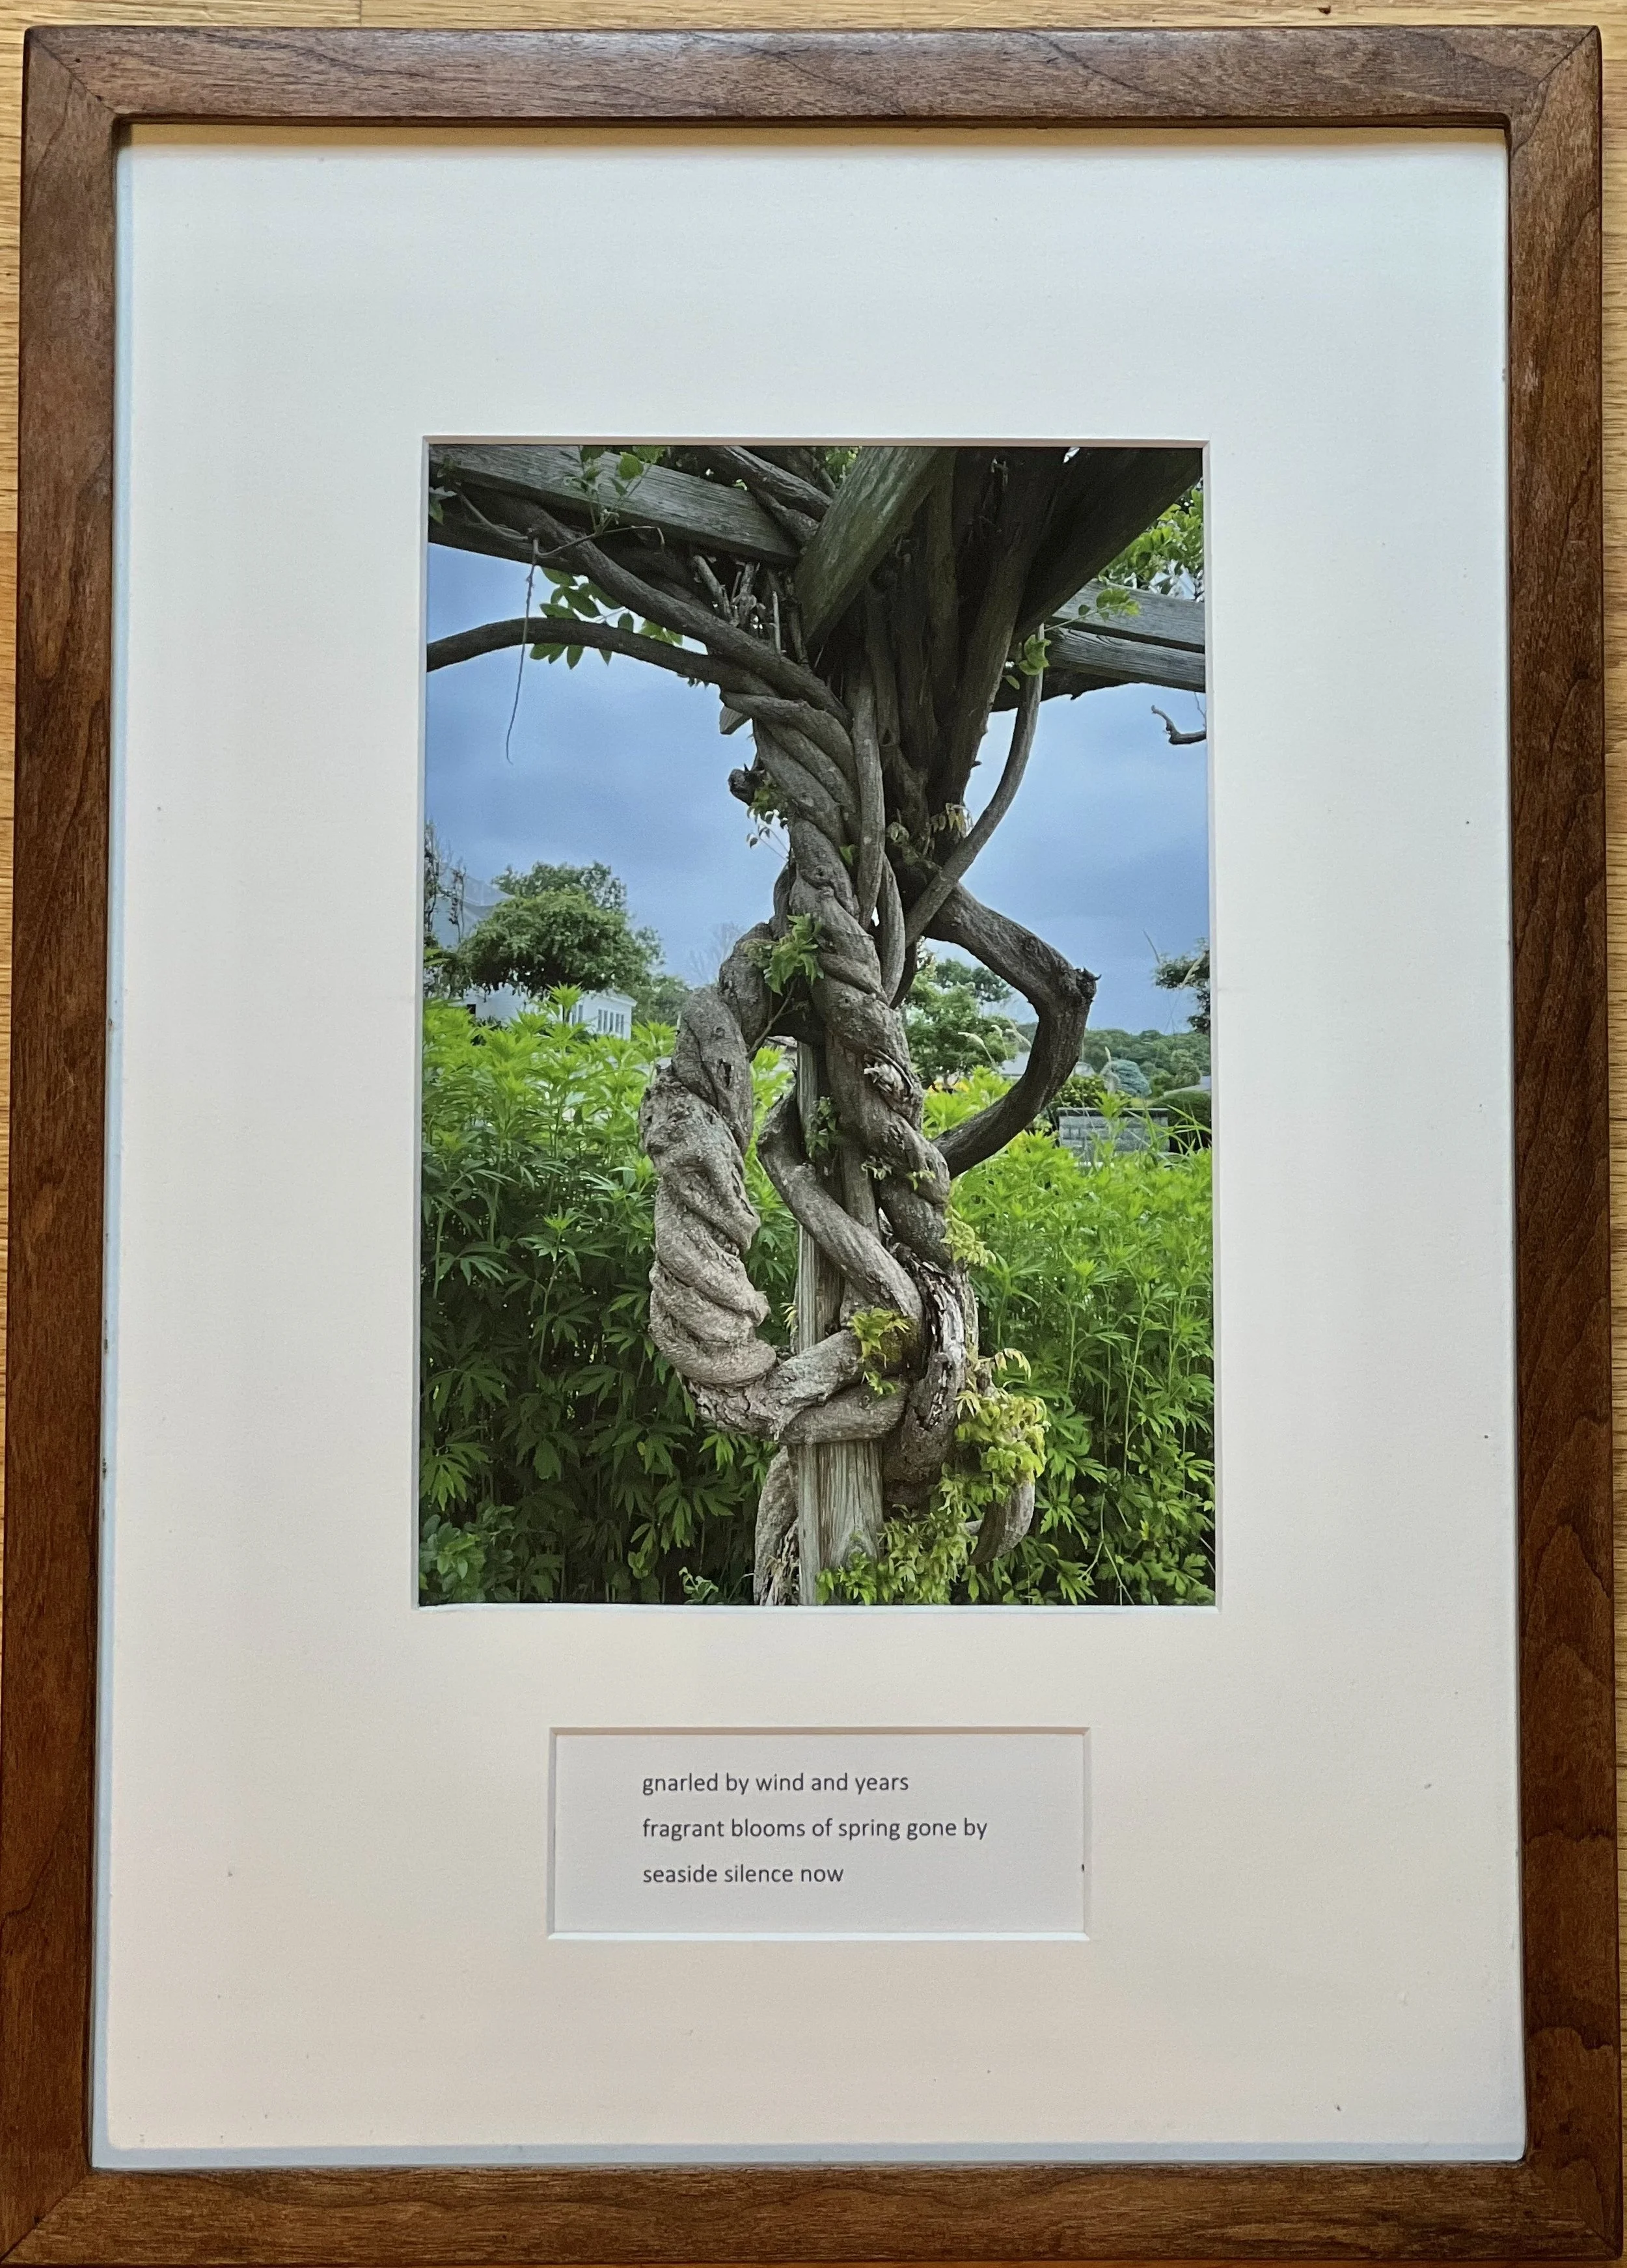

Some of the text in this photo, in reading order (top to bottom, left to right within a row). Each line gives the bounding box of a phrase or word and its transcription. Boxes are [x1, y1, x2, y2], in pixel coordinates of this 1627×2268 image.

[642, 1772, 909, 1796] gnarled by wind and years
[642, 1817, 988, 1842] fragrant blooms of spring gone by
[643, 1863, 844, 1883] seaside silence now
